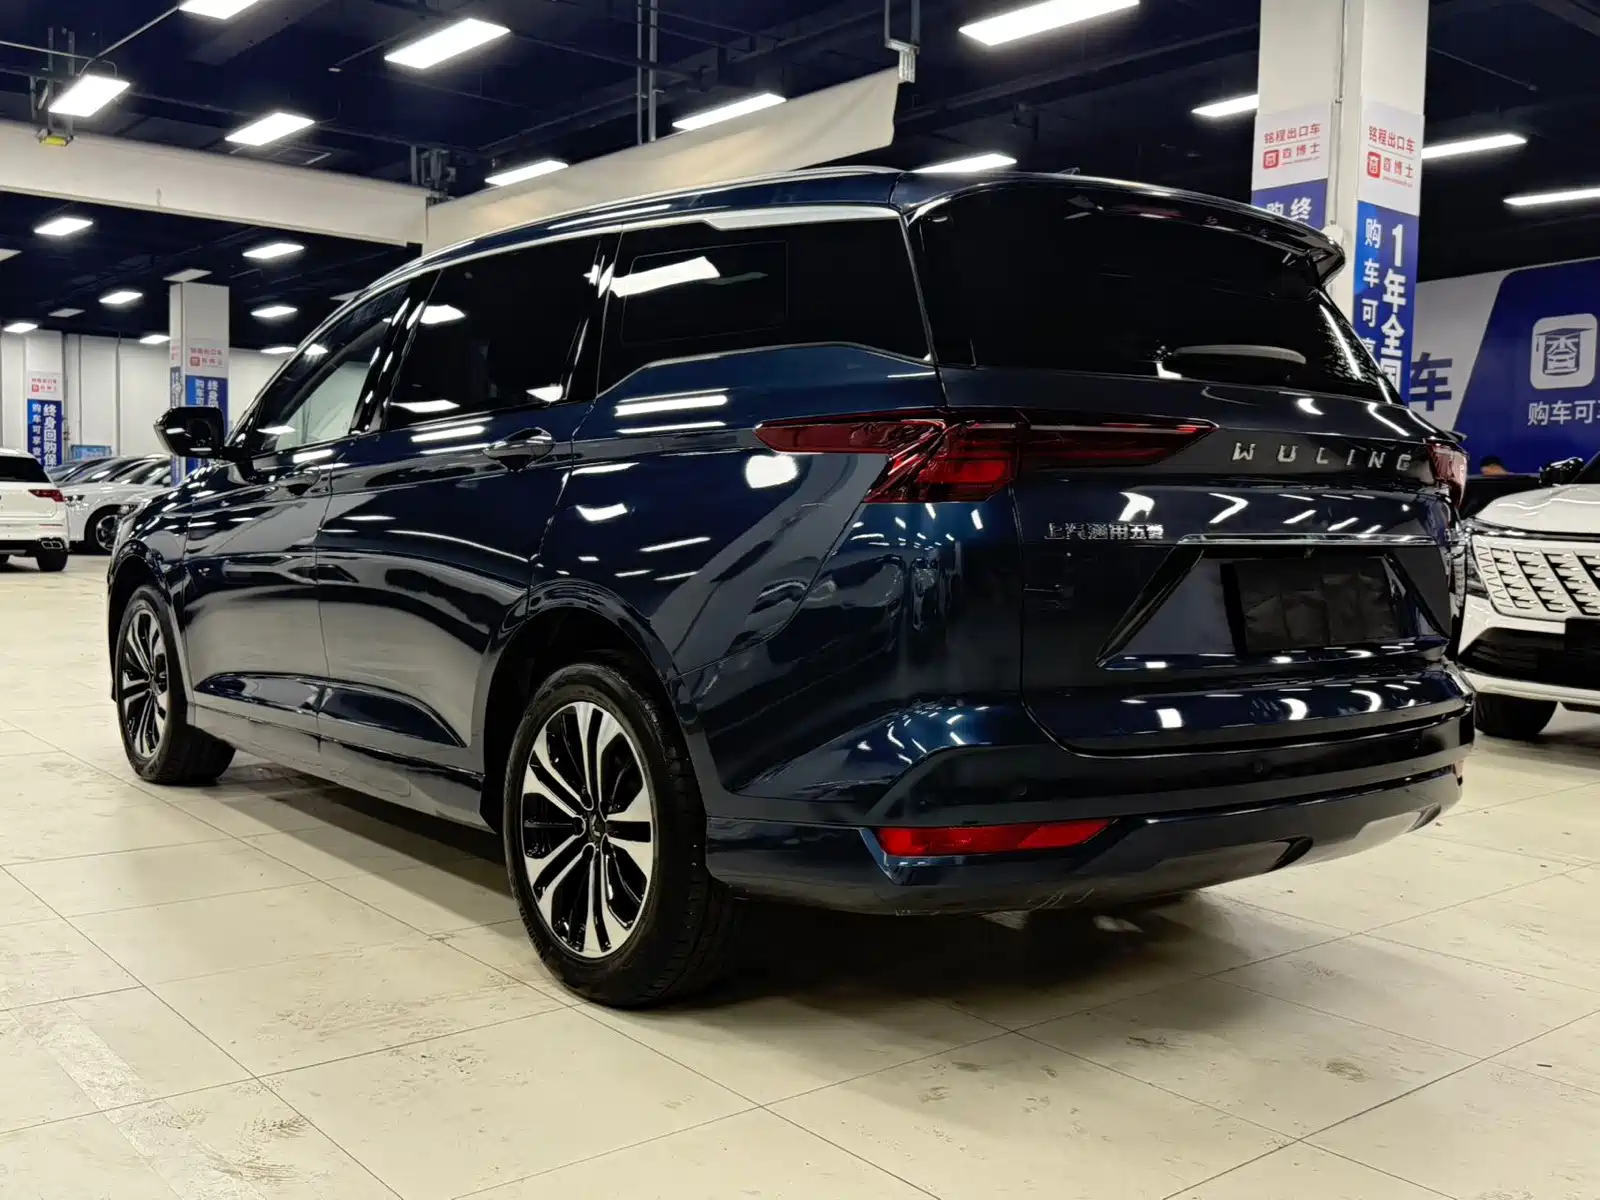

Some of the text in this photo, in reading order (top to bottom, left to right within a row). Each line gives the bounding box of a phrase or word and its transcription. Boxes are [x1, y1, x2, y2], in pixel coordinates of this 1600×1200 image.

[1527, 400, 1600, 426] 购车可
[1232, 442, 1412, 471] WULING
